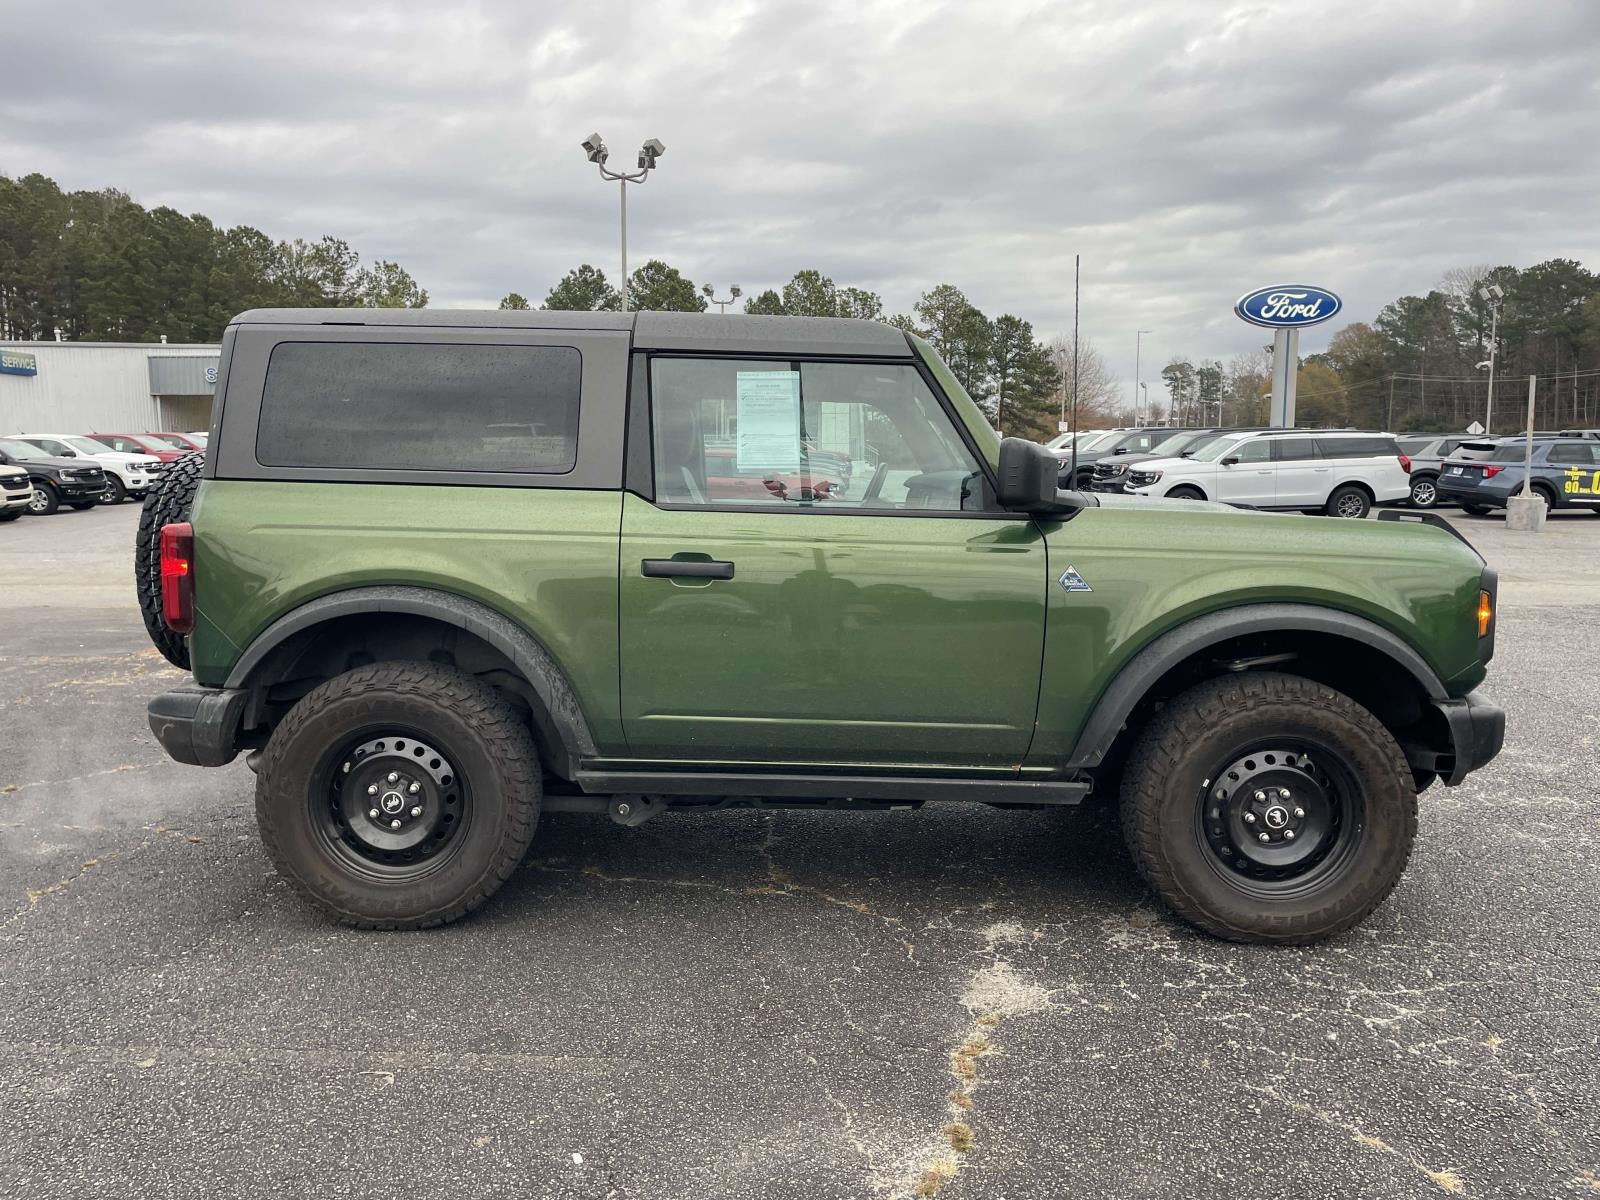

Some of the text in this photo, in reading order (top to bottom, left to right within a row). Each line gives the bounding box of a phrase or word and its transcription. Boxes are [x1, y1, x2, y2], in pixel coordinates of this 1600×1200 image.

[1260, 292, 1322, 319] Ford
[2, 356, 36, 370] SERVICE
[1564, 481, 1579, 494] 90
